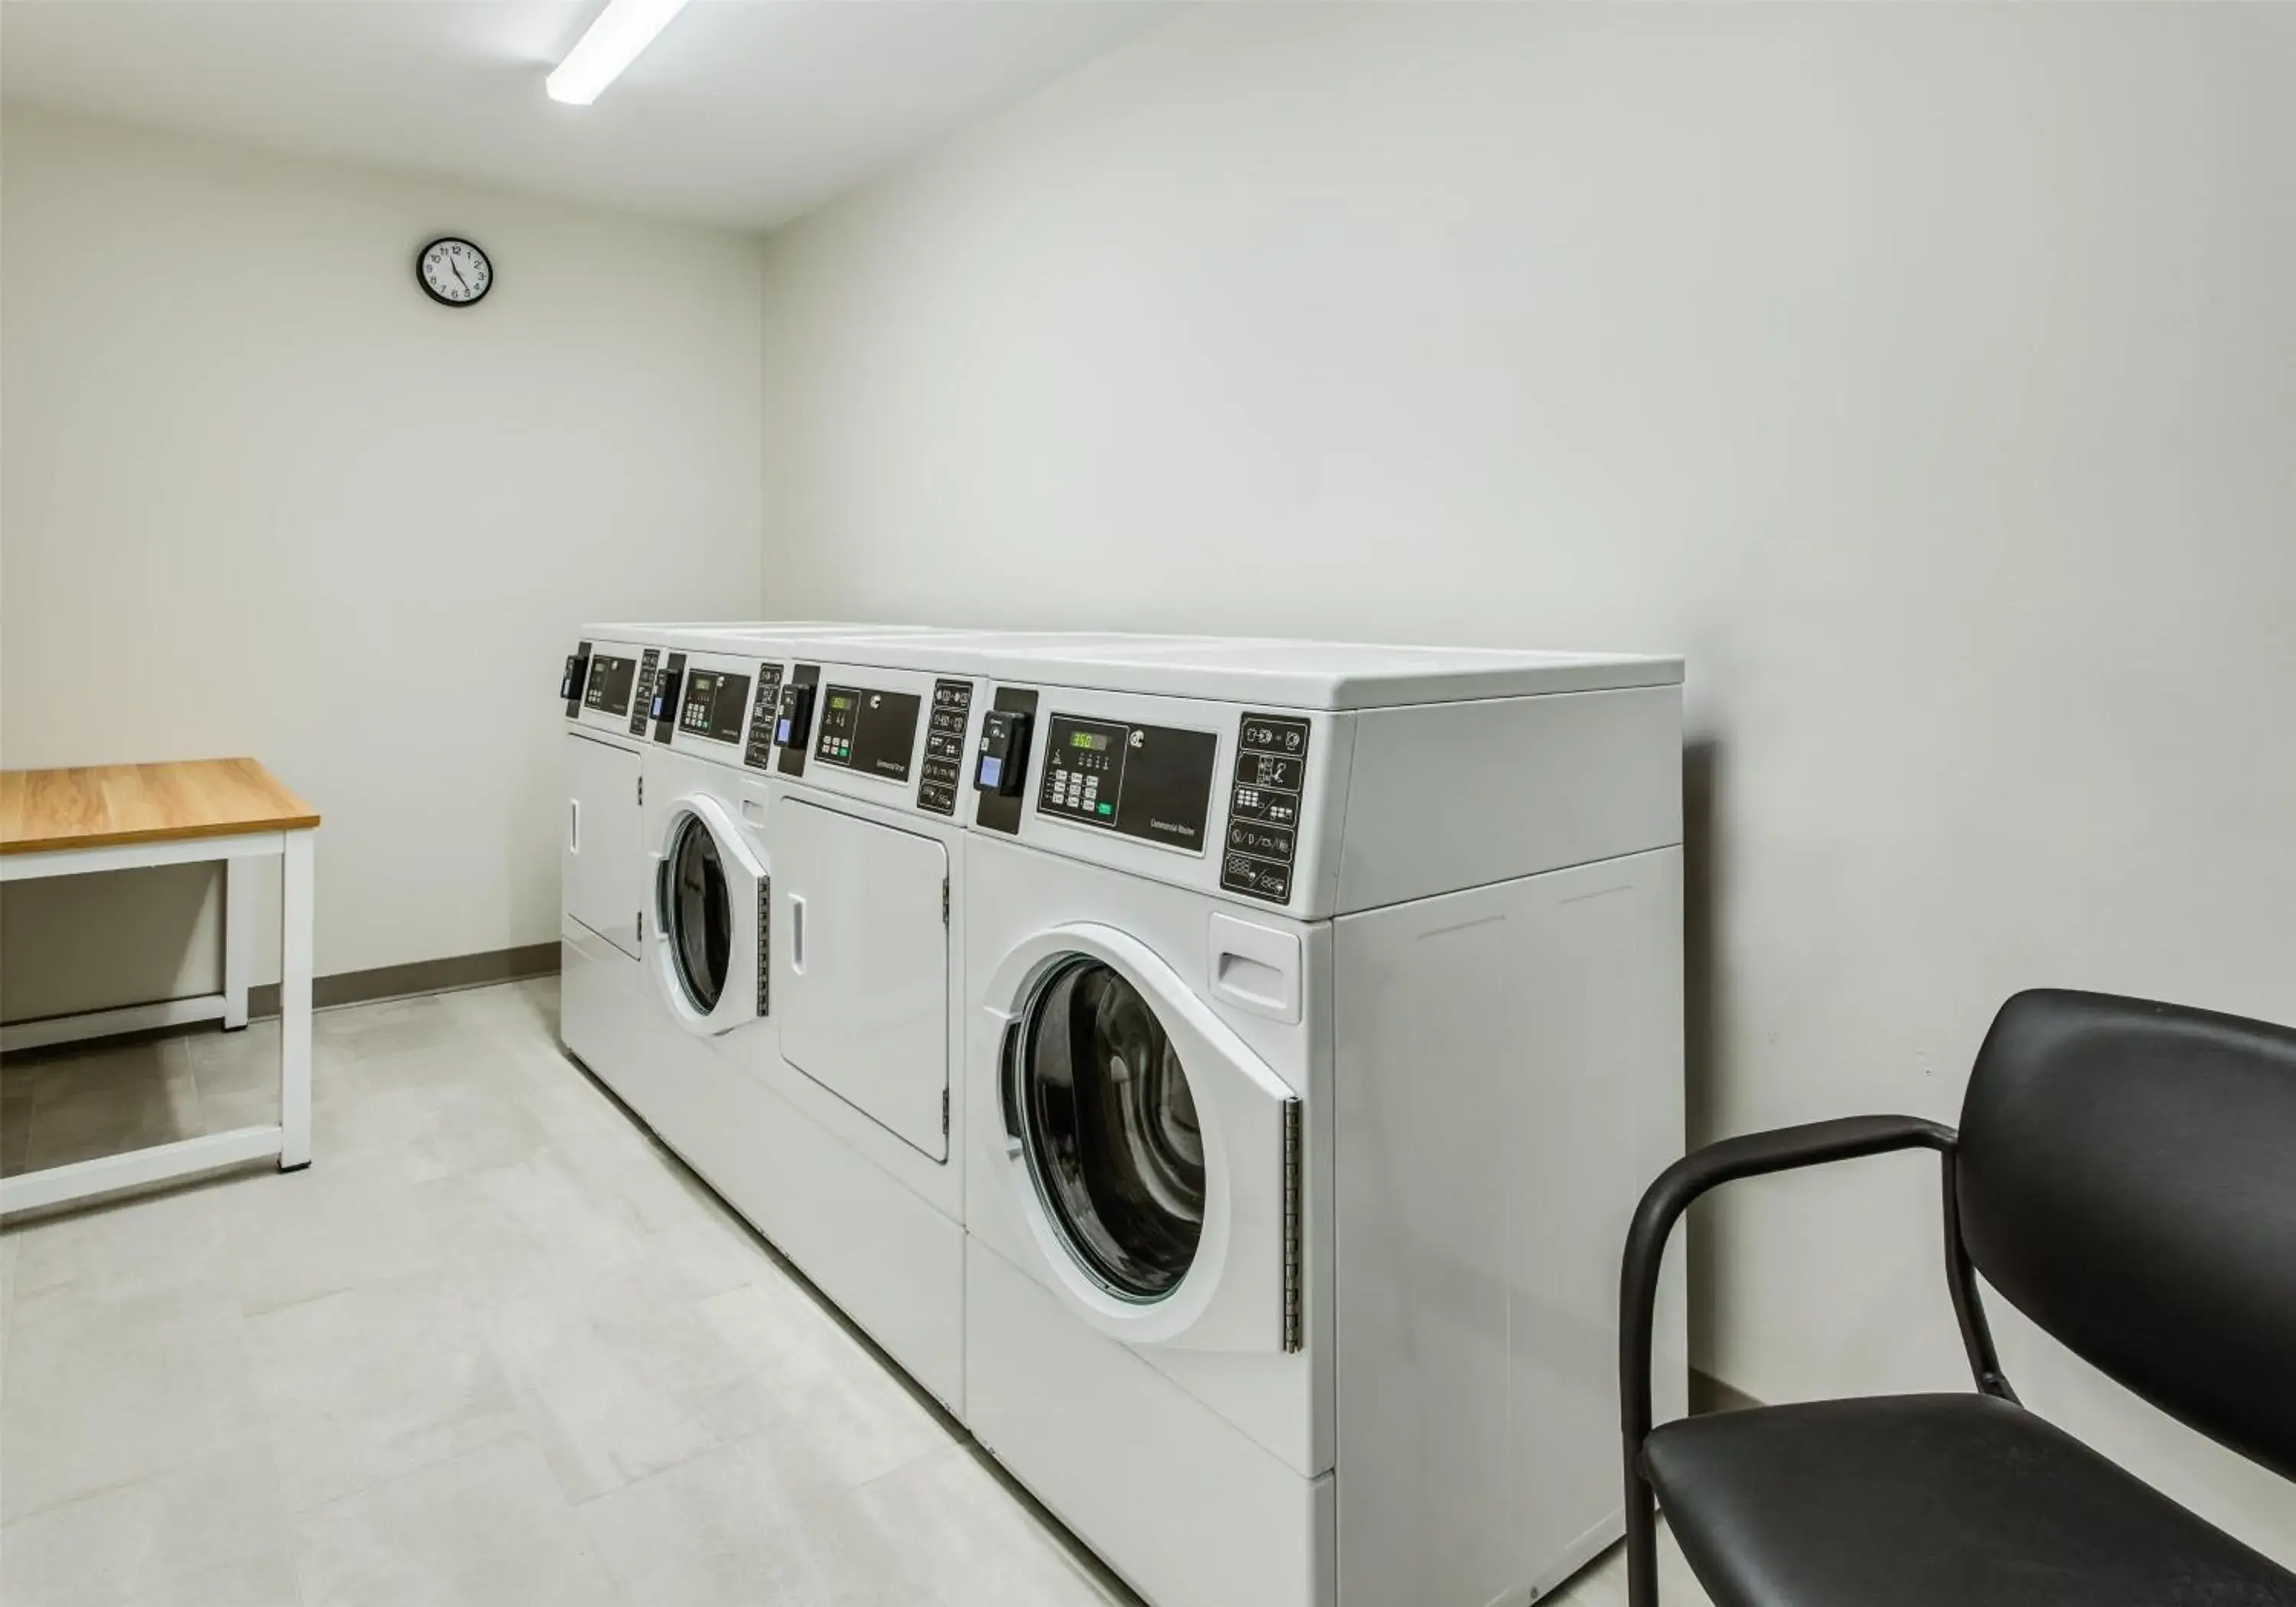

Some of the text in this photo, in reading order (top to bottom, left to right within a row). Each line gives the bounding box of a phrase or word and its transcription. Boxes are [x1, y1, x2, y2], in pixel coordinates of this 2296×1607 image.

[440, 246, 448, 256] 11
[452, 245, 462, 256] 12
[430, 255, 442, 264] 10
[426, 264, 433, 273] 9
[474, 260, 483, 269] 2
[478, 272, 484, 281] 3
[473, 282, 480, 291] 4
[451, 289, 459, 298] 6
[464, 288, 471, 298] 5
